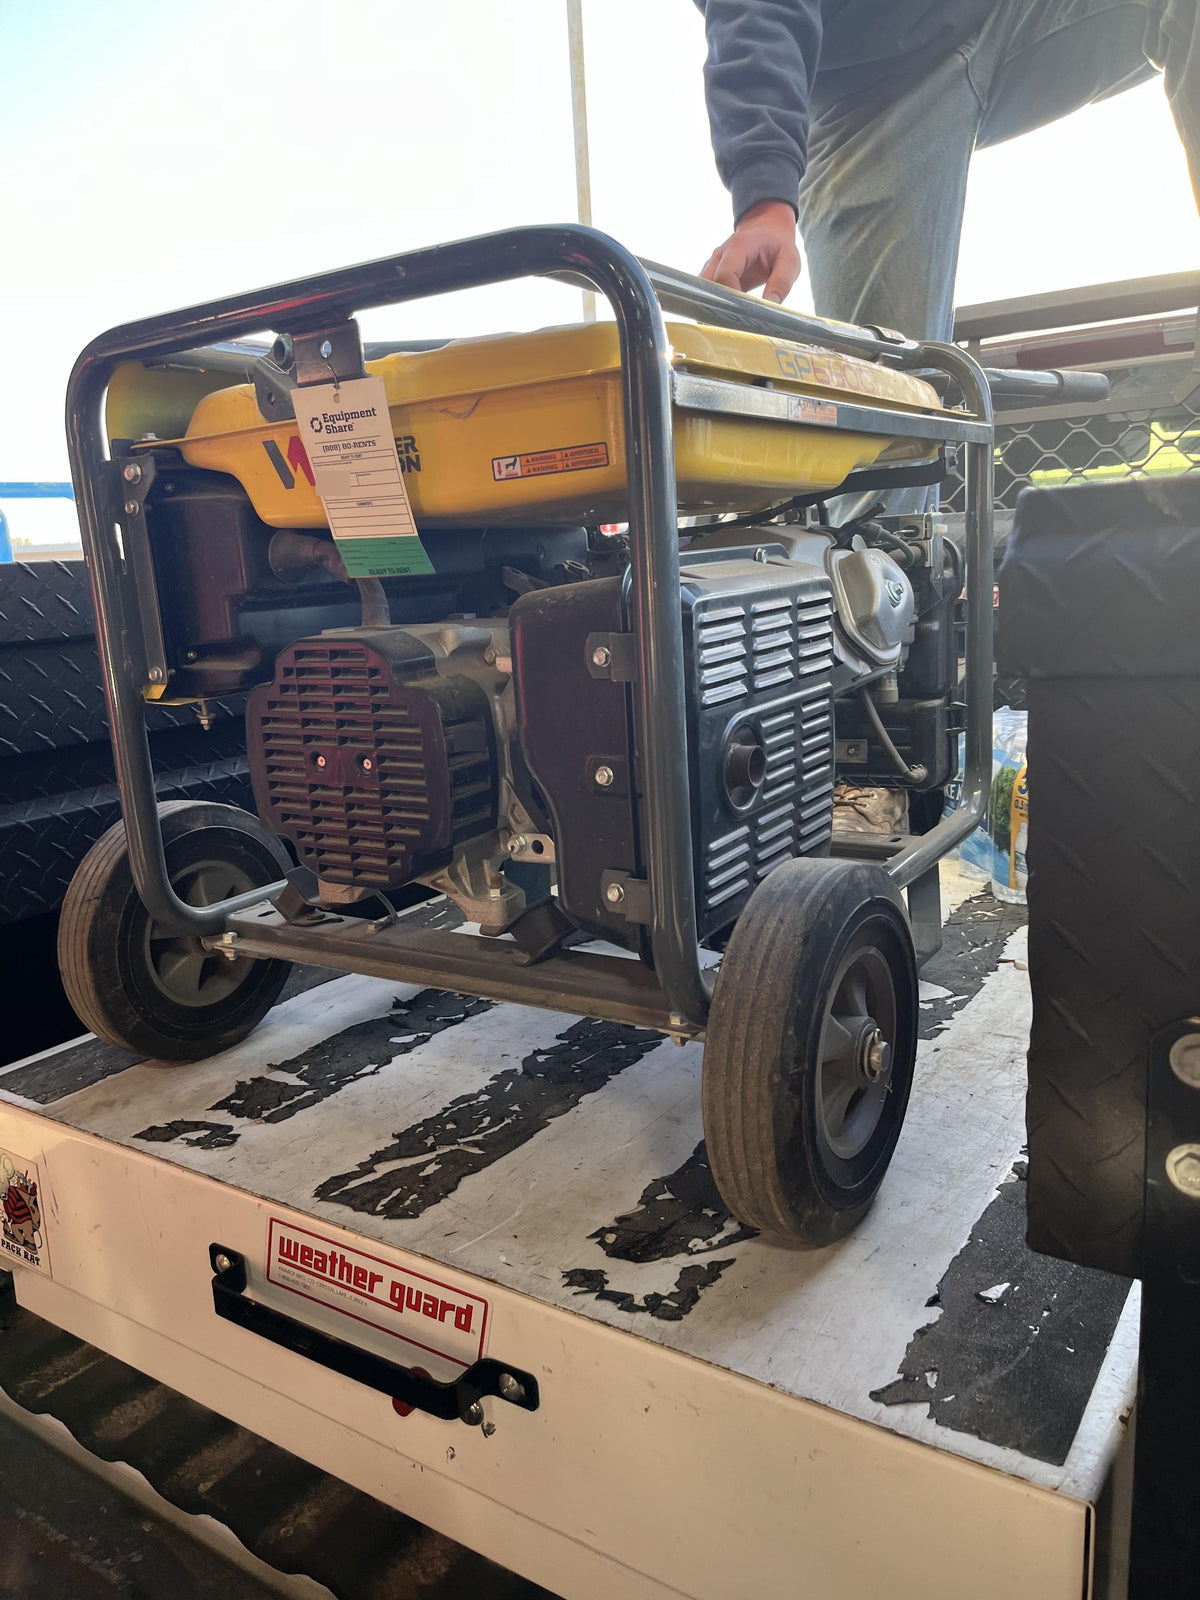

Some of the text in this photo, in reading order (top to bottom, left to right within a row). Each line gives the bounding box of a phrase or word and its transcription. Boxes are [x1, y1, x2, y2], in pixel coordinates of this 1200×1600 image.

[322, 407, 377, 424] Equipment
[325, 423, 354, 435] Share
[322, 443, 341, 453] (888)
[530, 454, 557, 463] WARNING
[531, 464, 558, 473] WARNING
[368, 567, 386, 575] READY
[396, 566, 411, 574] RENT
[1, 1239, 41, 1267] PACK RAT
[279, 1236, 473, 1333] weather guard
